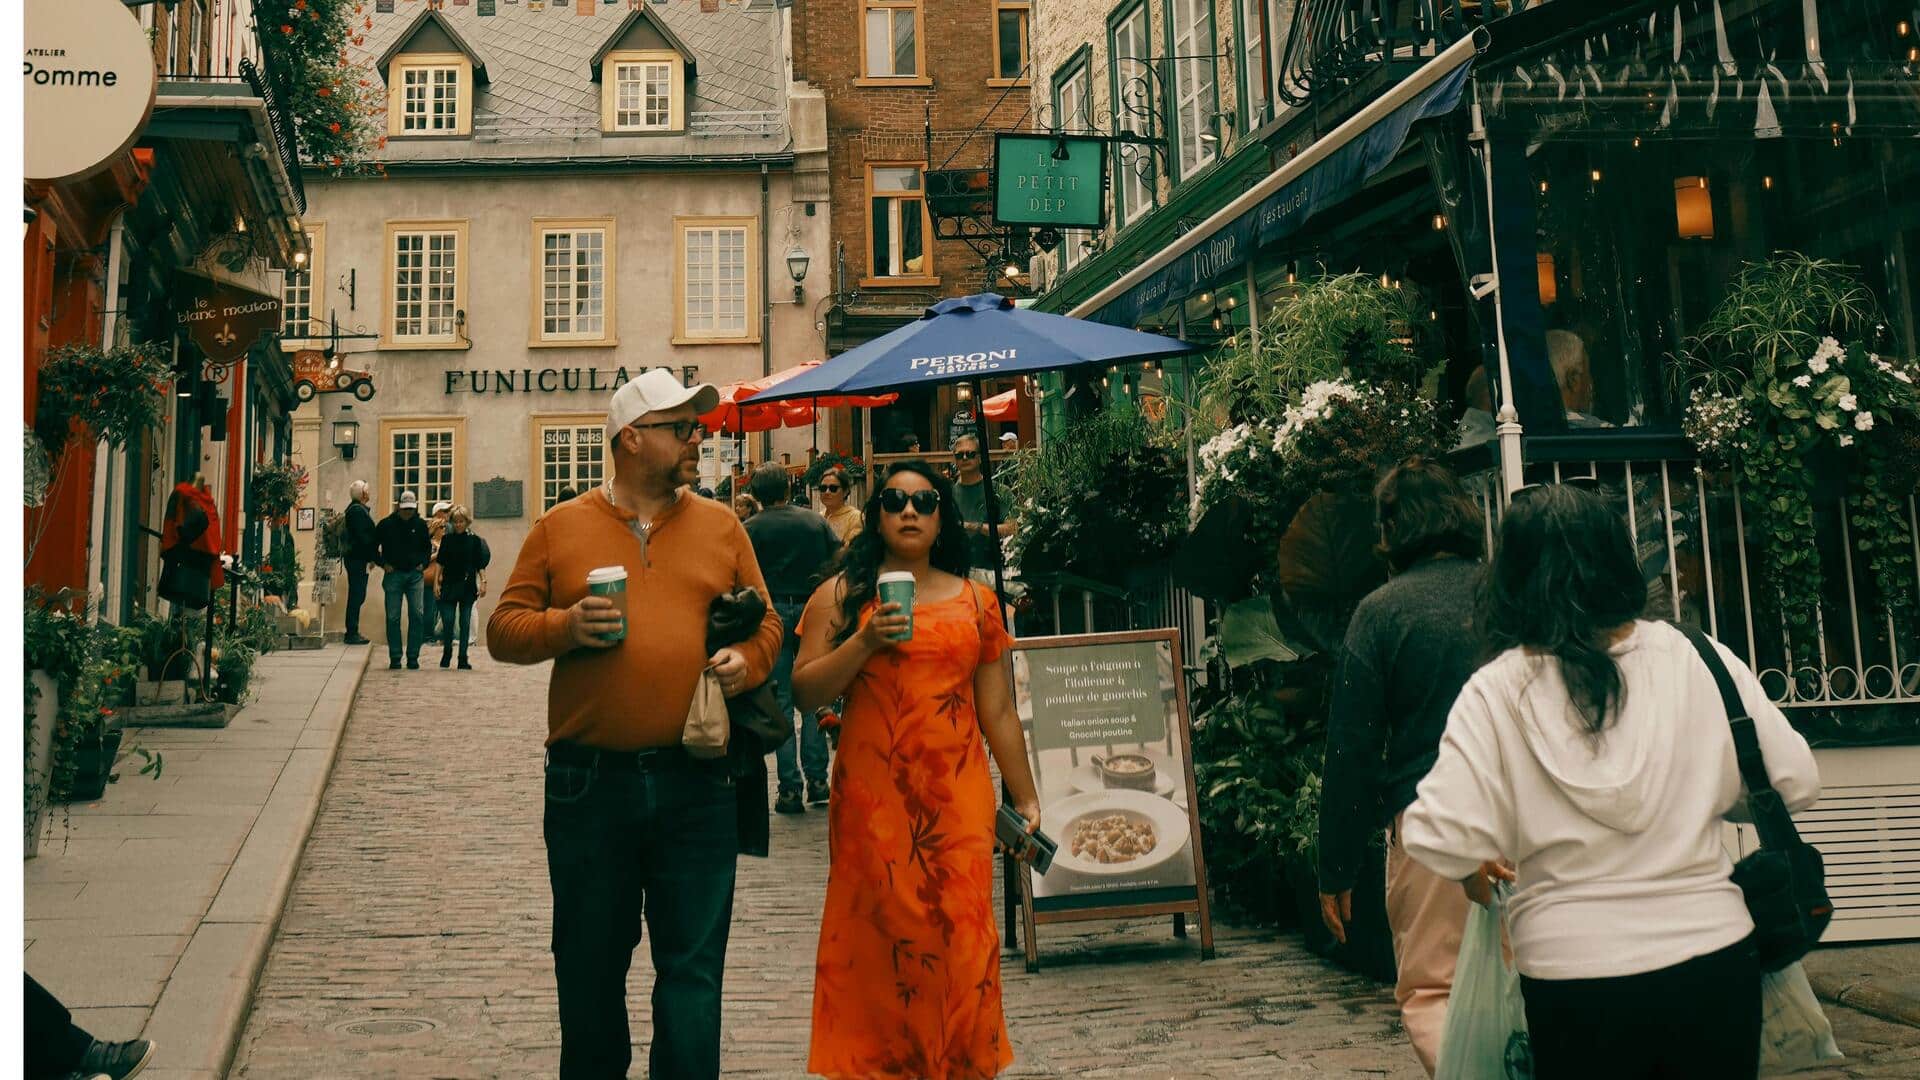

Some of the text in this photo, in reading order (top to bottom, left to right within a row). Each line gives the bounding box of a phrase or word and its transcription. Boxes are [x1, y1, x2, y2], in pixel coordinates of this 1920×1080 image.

[26, 49, 66, 57] ATELIER
[1037, 153, 1061, 169] LE
[1017, 175, 1080, 191] PETIT
[1030, 198, 1067, 213] DEP
[1262, 186, 1308, 227] restaurant
[177, 299, 278, 323] blanc mouton
[194, 297, 208, 309] le
[910, 348, 1017, 371] PERONI
[444, 365, 701, 395] FUNICULAE
[1045, 663, 1079, 676] Soupe
[1045, 688, 1148, 708] poutine de gnocchis
[1061, 717, 1086, 728] Italian
[1087, 715, 1110, 726] onion
[1110, 714, 1130, 725] soup
[1069, 727, 1133, 740] Gnocchi poutine
